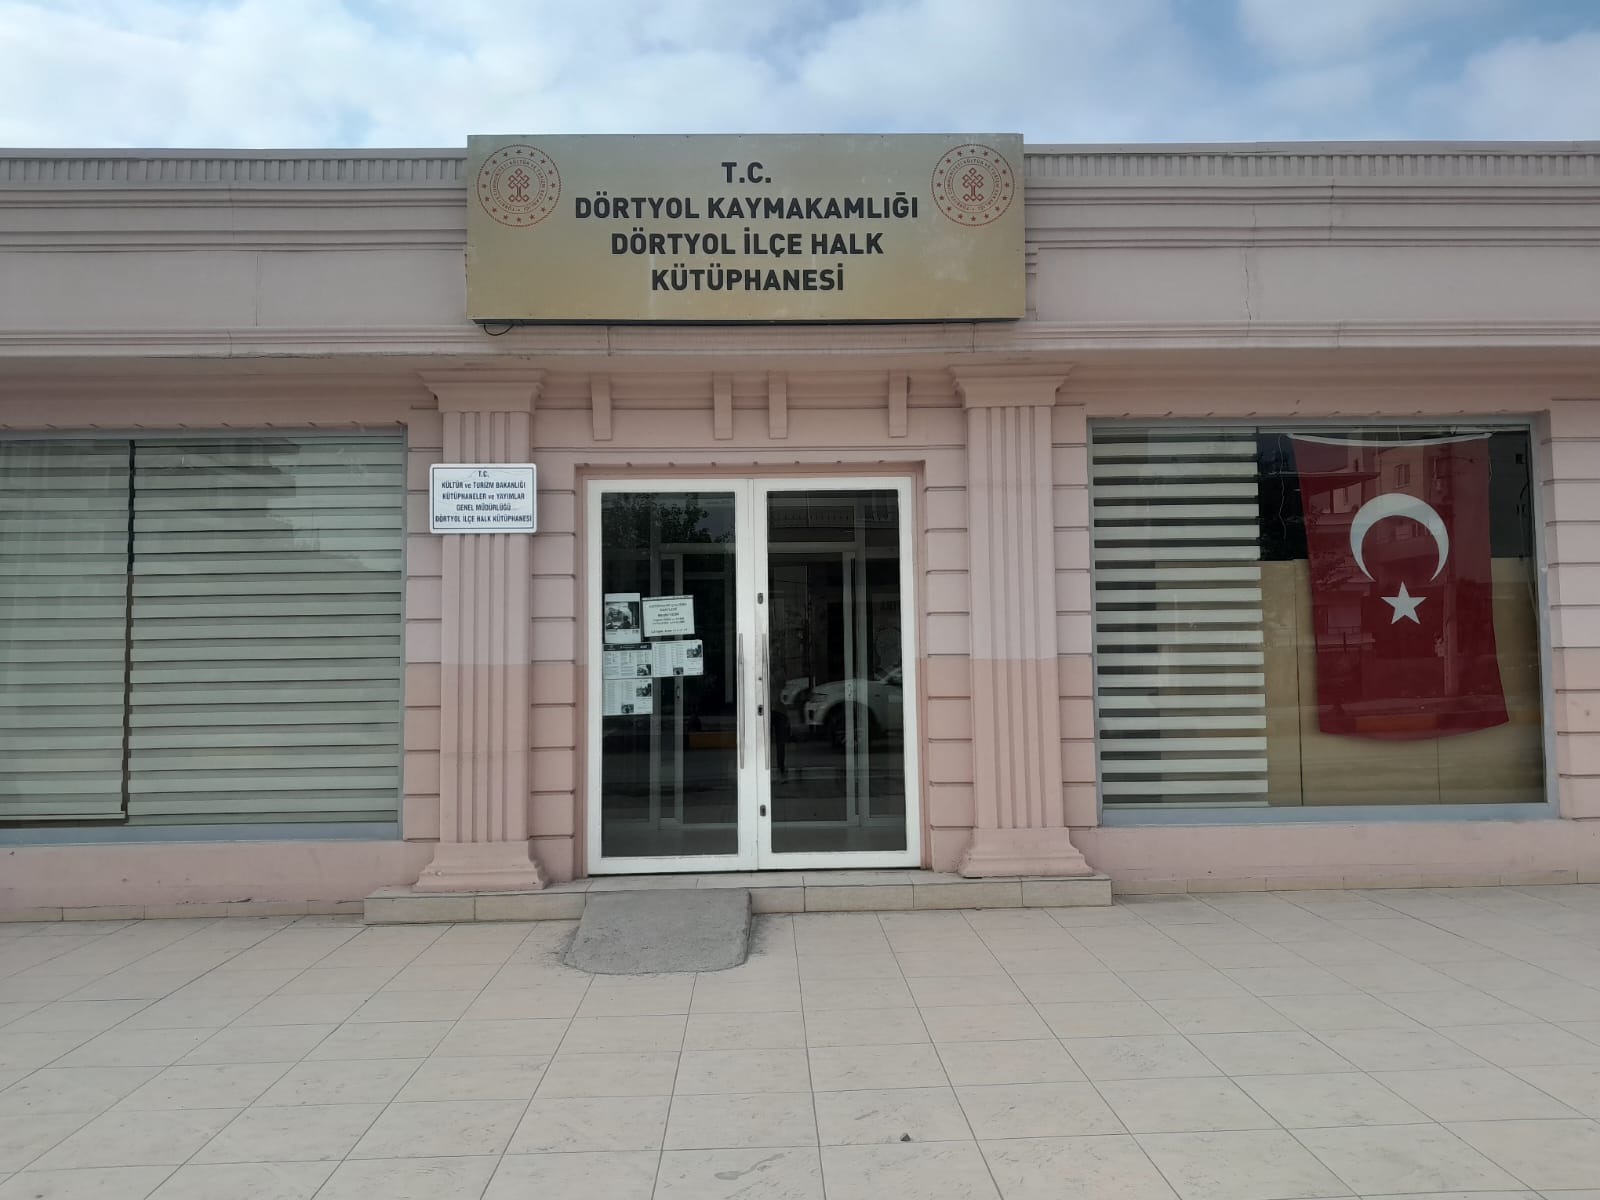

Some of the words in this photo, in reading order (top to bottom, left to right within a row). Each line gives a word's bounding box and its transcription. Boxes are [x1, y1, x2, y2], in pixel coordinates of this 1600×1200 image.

[722, 162, 772, 184] T.C.
[576, 191, 700, 219] DÖRTYOL
[708, 190, 918, 220] KAYMAKAMLIĞI
[612, 227, 736, 255] DÖRTYOL
[744, 226, 803, 257] İLÇE
[812, 232, 884, 255] HALK
[652, 262, 844, 291] KÜTÜPHANESİ
[441, 480, 464, 489] KÜLTÜR
[495, 480, 526, 489] BAKANLIĞI
[442, 491, 487, 500] KÜTÜPHANELER
[456, 503, 474, 512] GENEL
[475, 502, 512, 511] MÜDÜRLÜĞÜ
[435, 513, 461, 523] DÖRTYOL
[476, 515, 492, 523] HALK
[492, 513, 532, 522] KÜTÜPHANESİ
